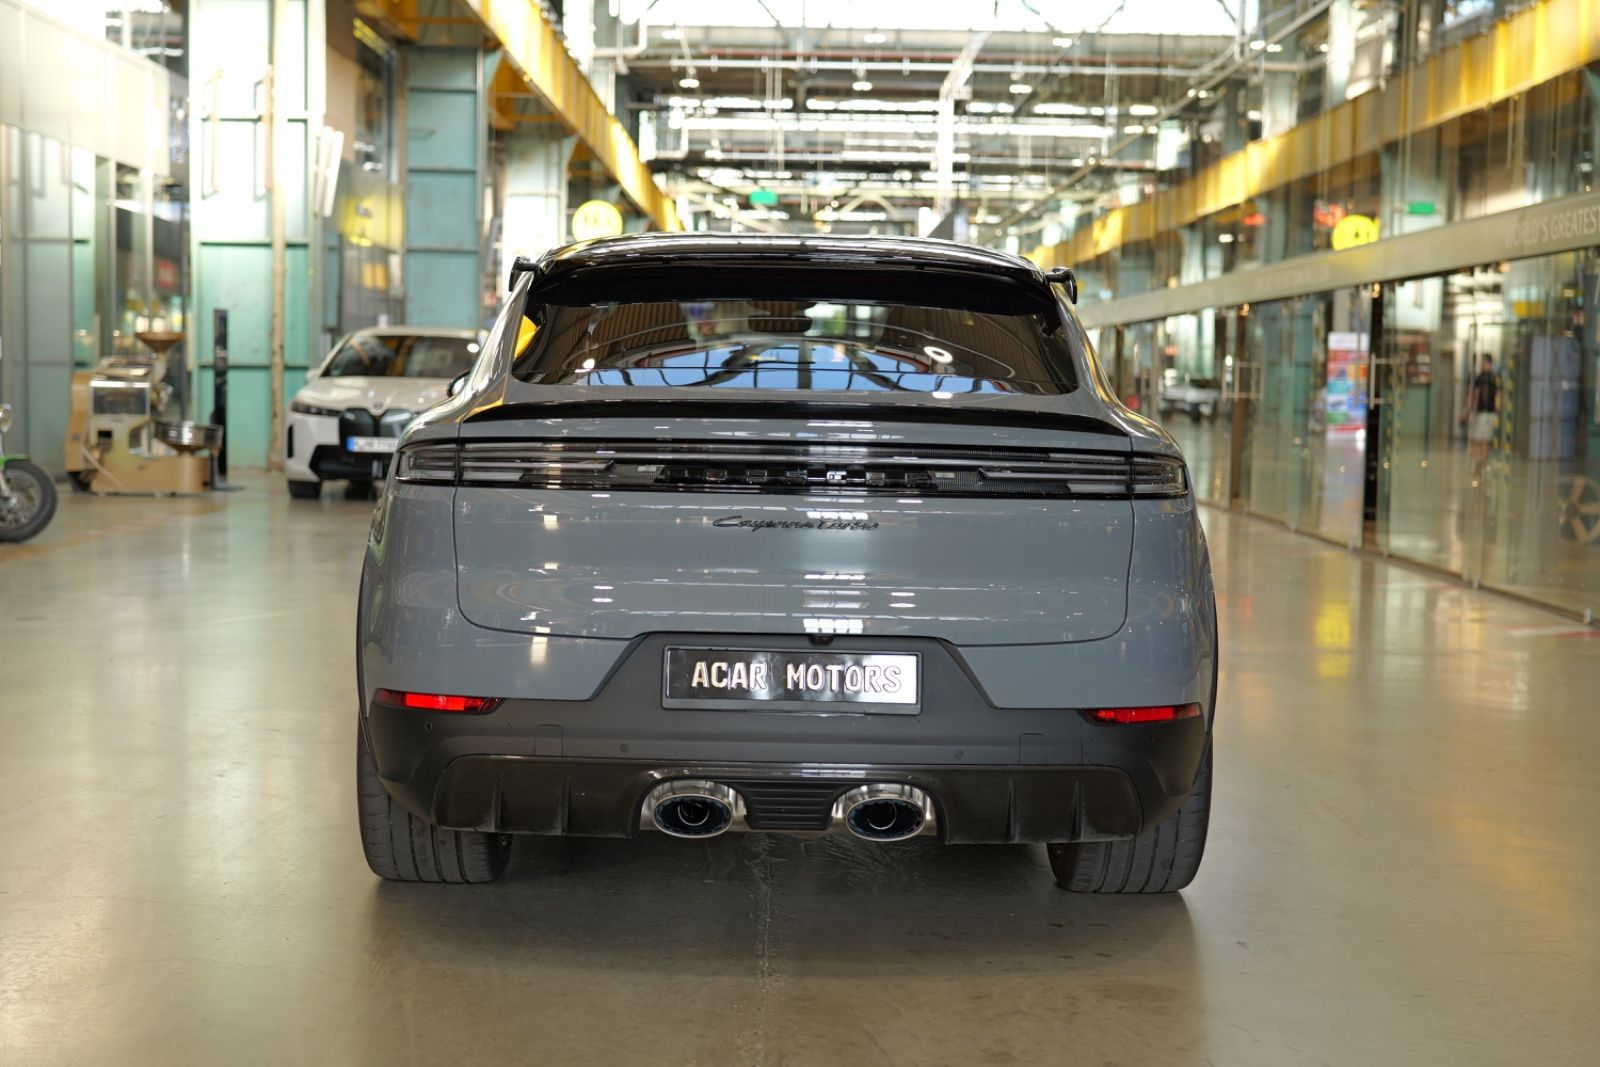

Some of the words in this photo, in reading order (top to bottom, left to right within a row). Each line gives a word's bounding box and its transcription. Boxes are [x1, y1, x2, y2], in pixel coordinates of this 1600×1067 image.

[713, 515, 814, 532] Cayenne
[691, 661, 768, 689] ACAR
[786, 663, 901, 693] MOTORS
